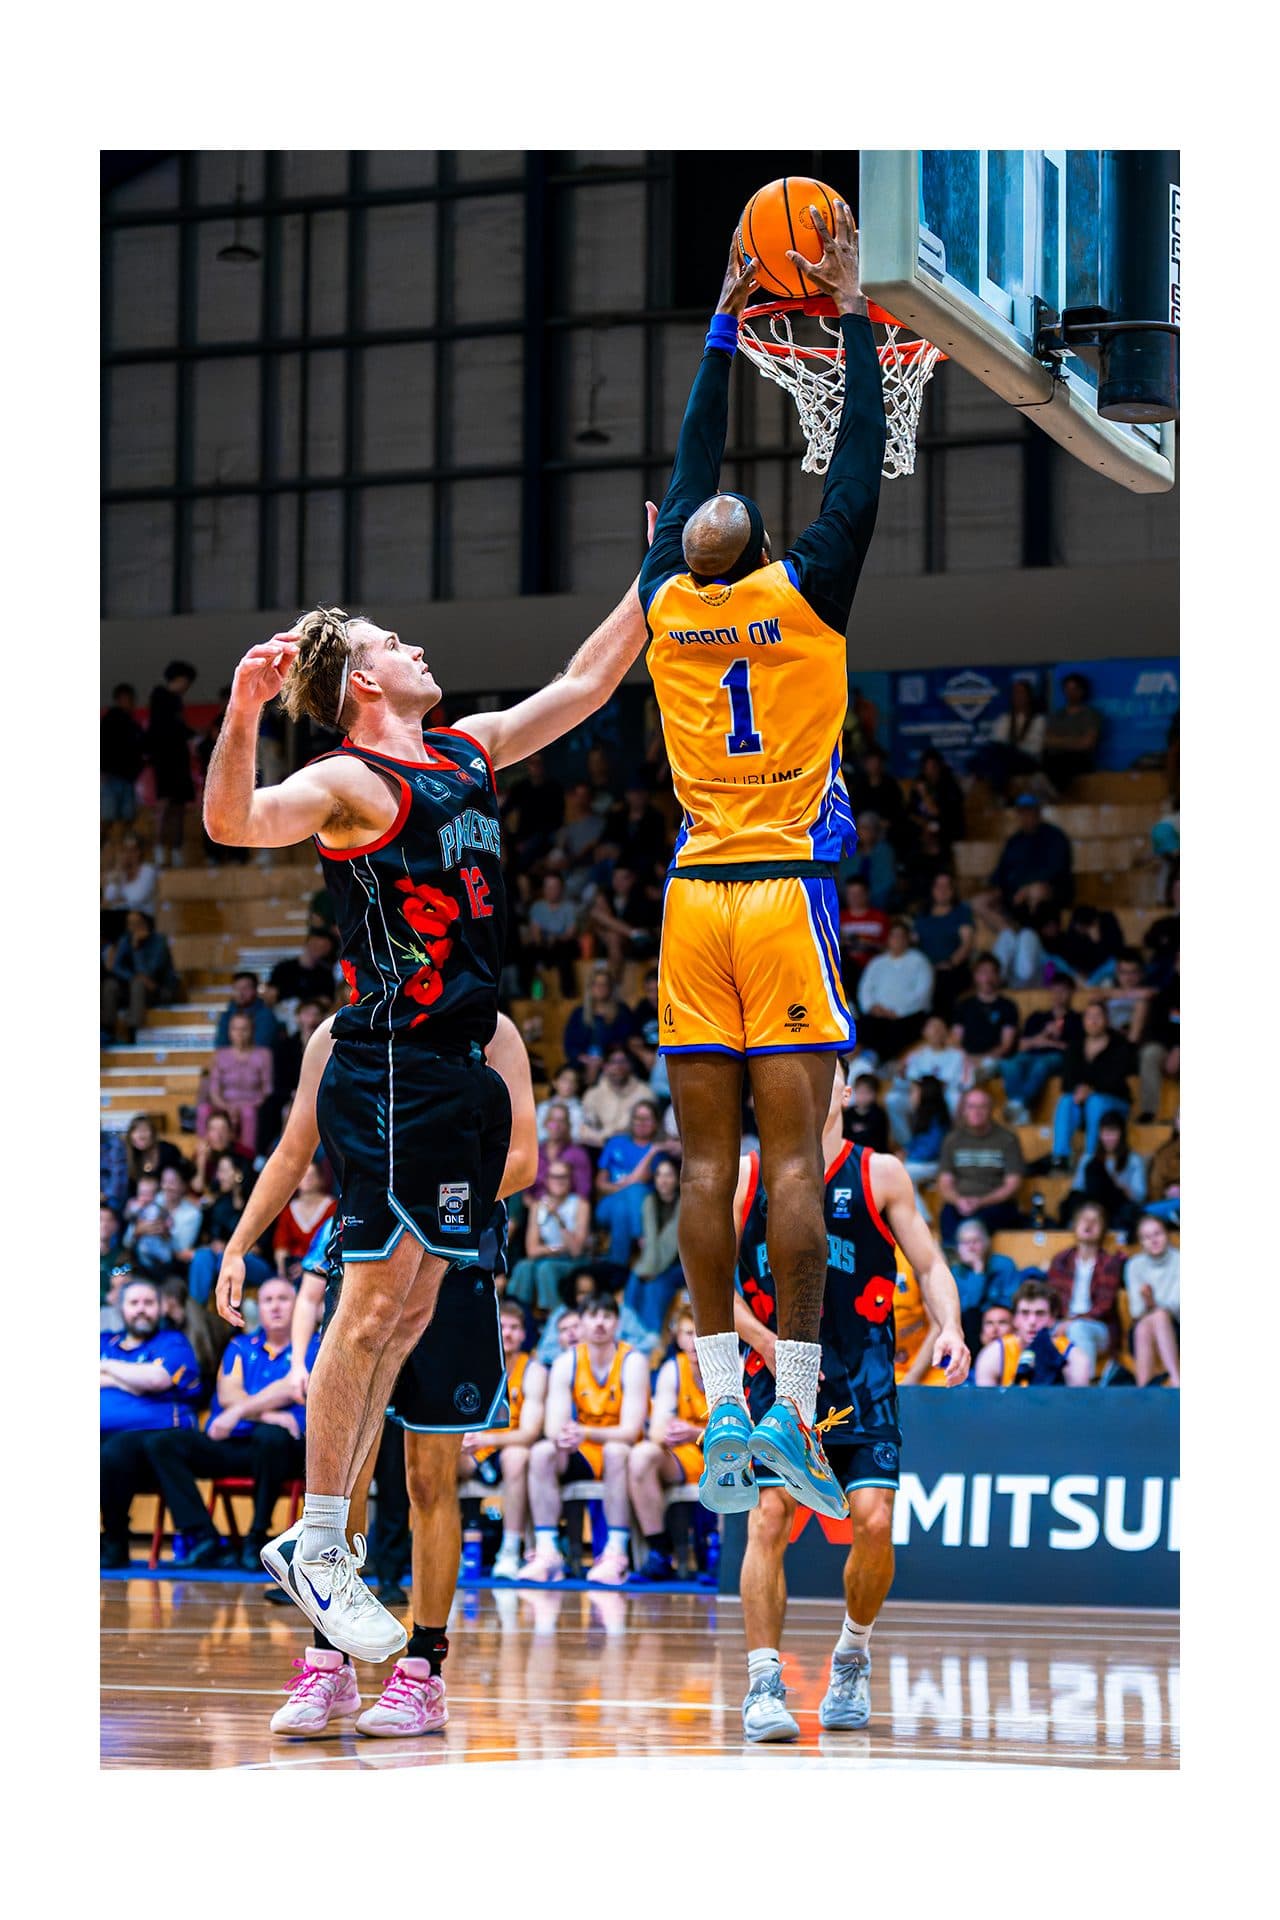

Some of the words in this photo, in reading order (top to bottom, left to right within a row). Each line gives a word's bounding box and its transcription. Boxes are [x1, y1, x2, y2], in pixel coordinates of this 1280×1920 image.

[720, 657, 764, 757] 1
[460, 866, 494, 919] 12
[444, 1214, 465, 1224] ONE
[891, 1472, 1180, 1551] MITSU
